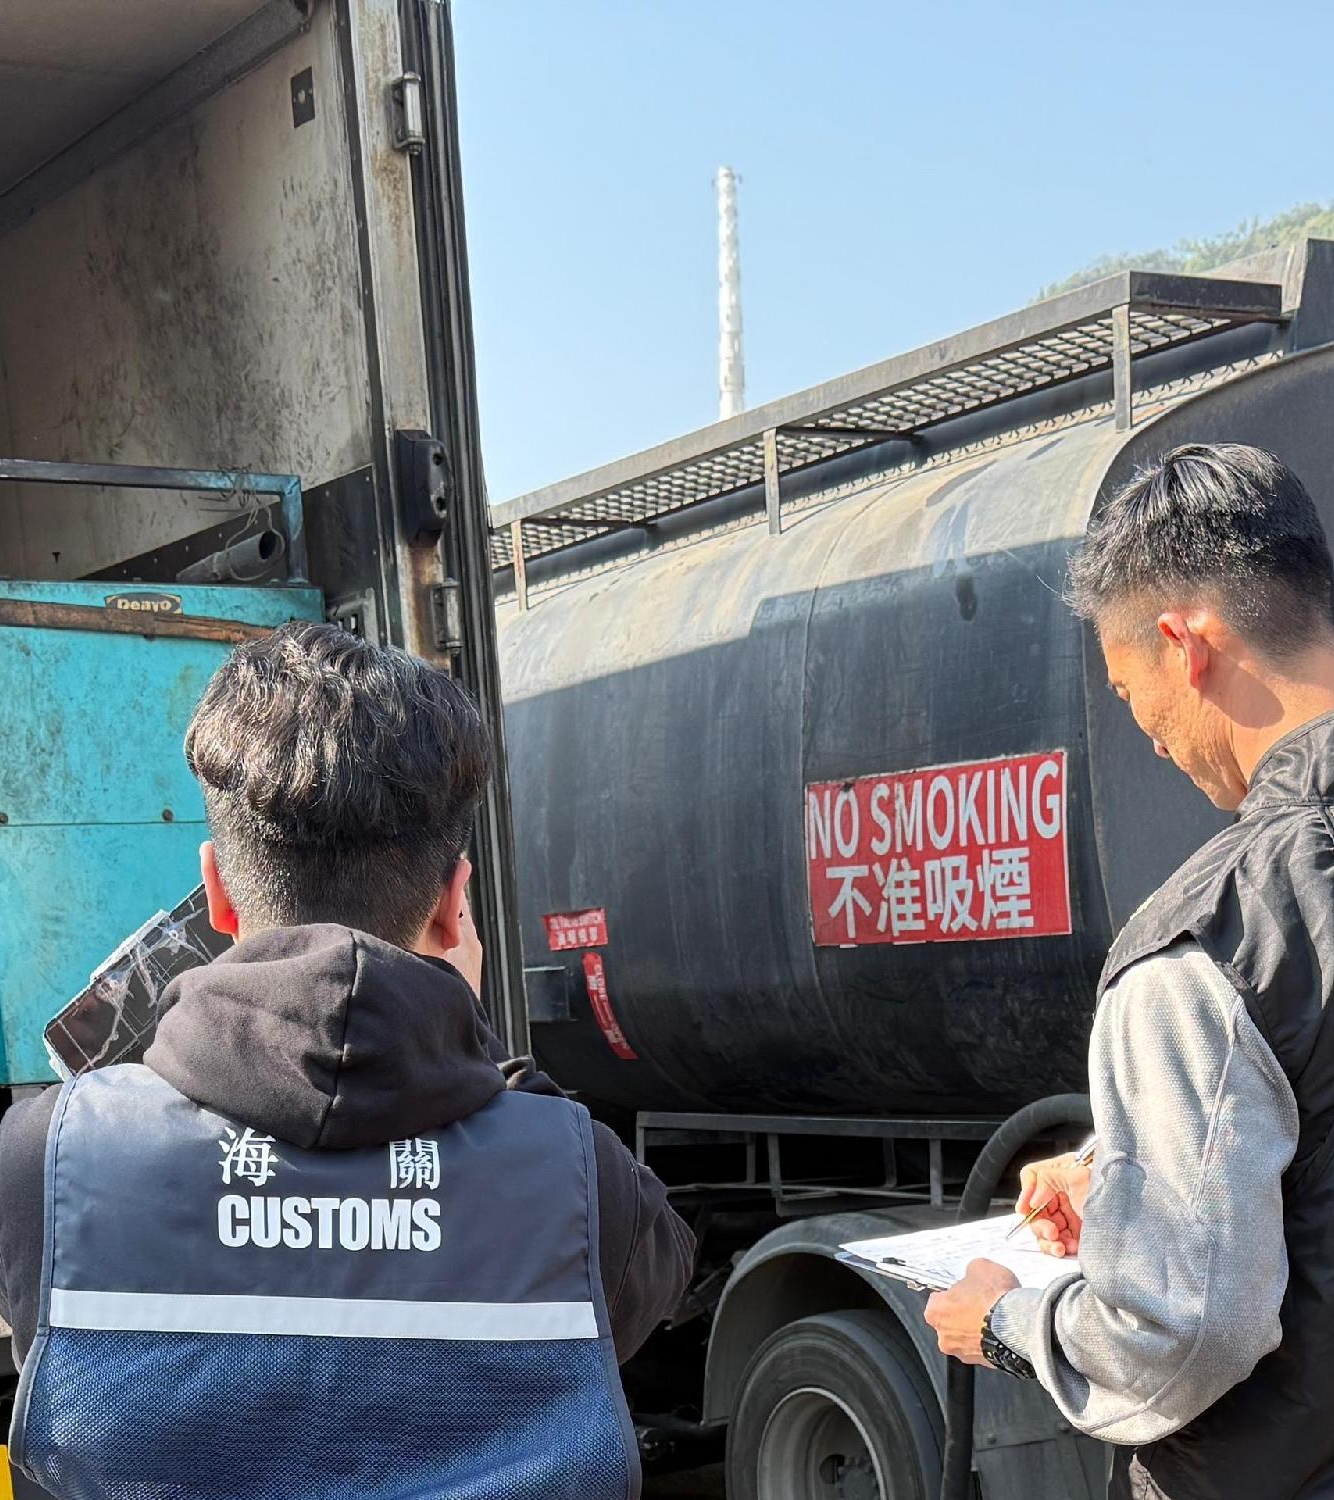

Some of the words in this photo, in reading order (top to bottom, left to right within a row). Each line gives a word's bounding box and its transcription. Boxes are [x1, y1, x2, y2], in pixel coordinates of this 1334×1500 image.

[809, 789, 860, 860] NO
[870, 760, 1061, 856] SMOKING
[826, 847, 1034, 938] 不准吸煙
[218, 1126, 441, 1190] 海關
[217, 1194, 442, 1252] CUSTOMS
